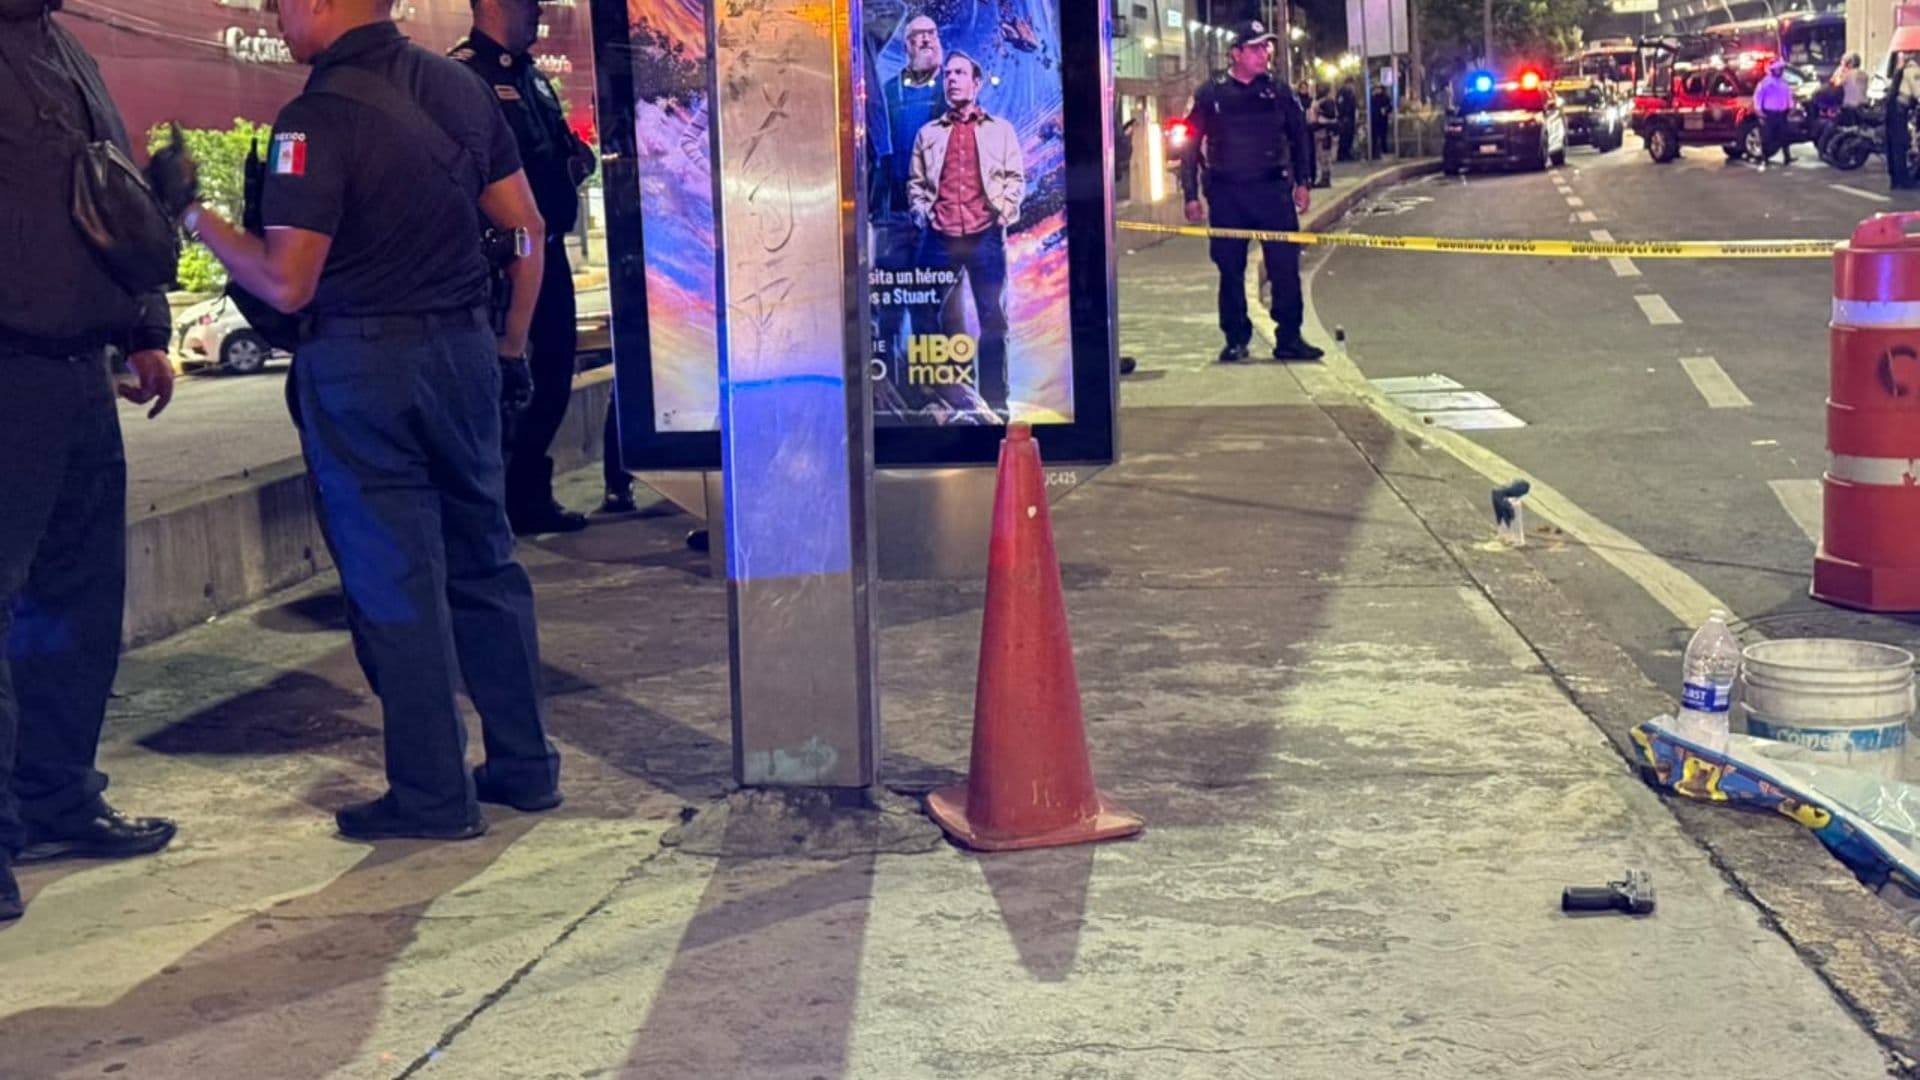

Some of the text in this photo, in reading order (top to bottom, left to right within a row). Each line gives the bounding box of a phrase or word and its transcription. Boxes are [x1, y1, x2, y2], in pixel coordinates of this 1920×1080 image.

[896, 272, 912, 284] un
[915, 267, 958, 284] héroe.
[882, 292, 891, 304] a
[893, 288, 941, 304] Stuart.
[907, 333, 975, 363] HBO
[908, 365, 974, 385] max
